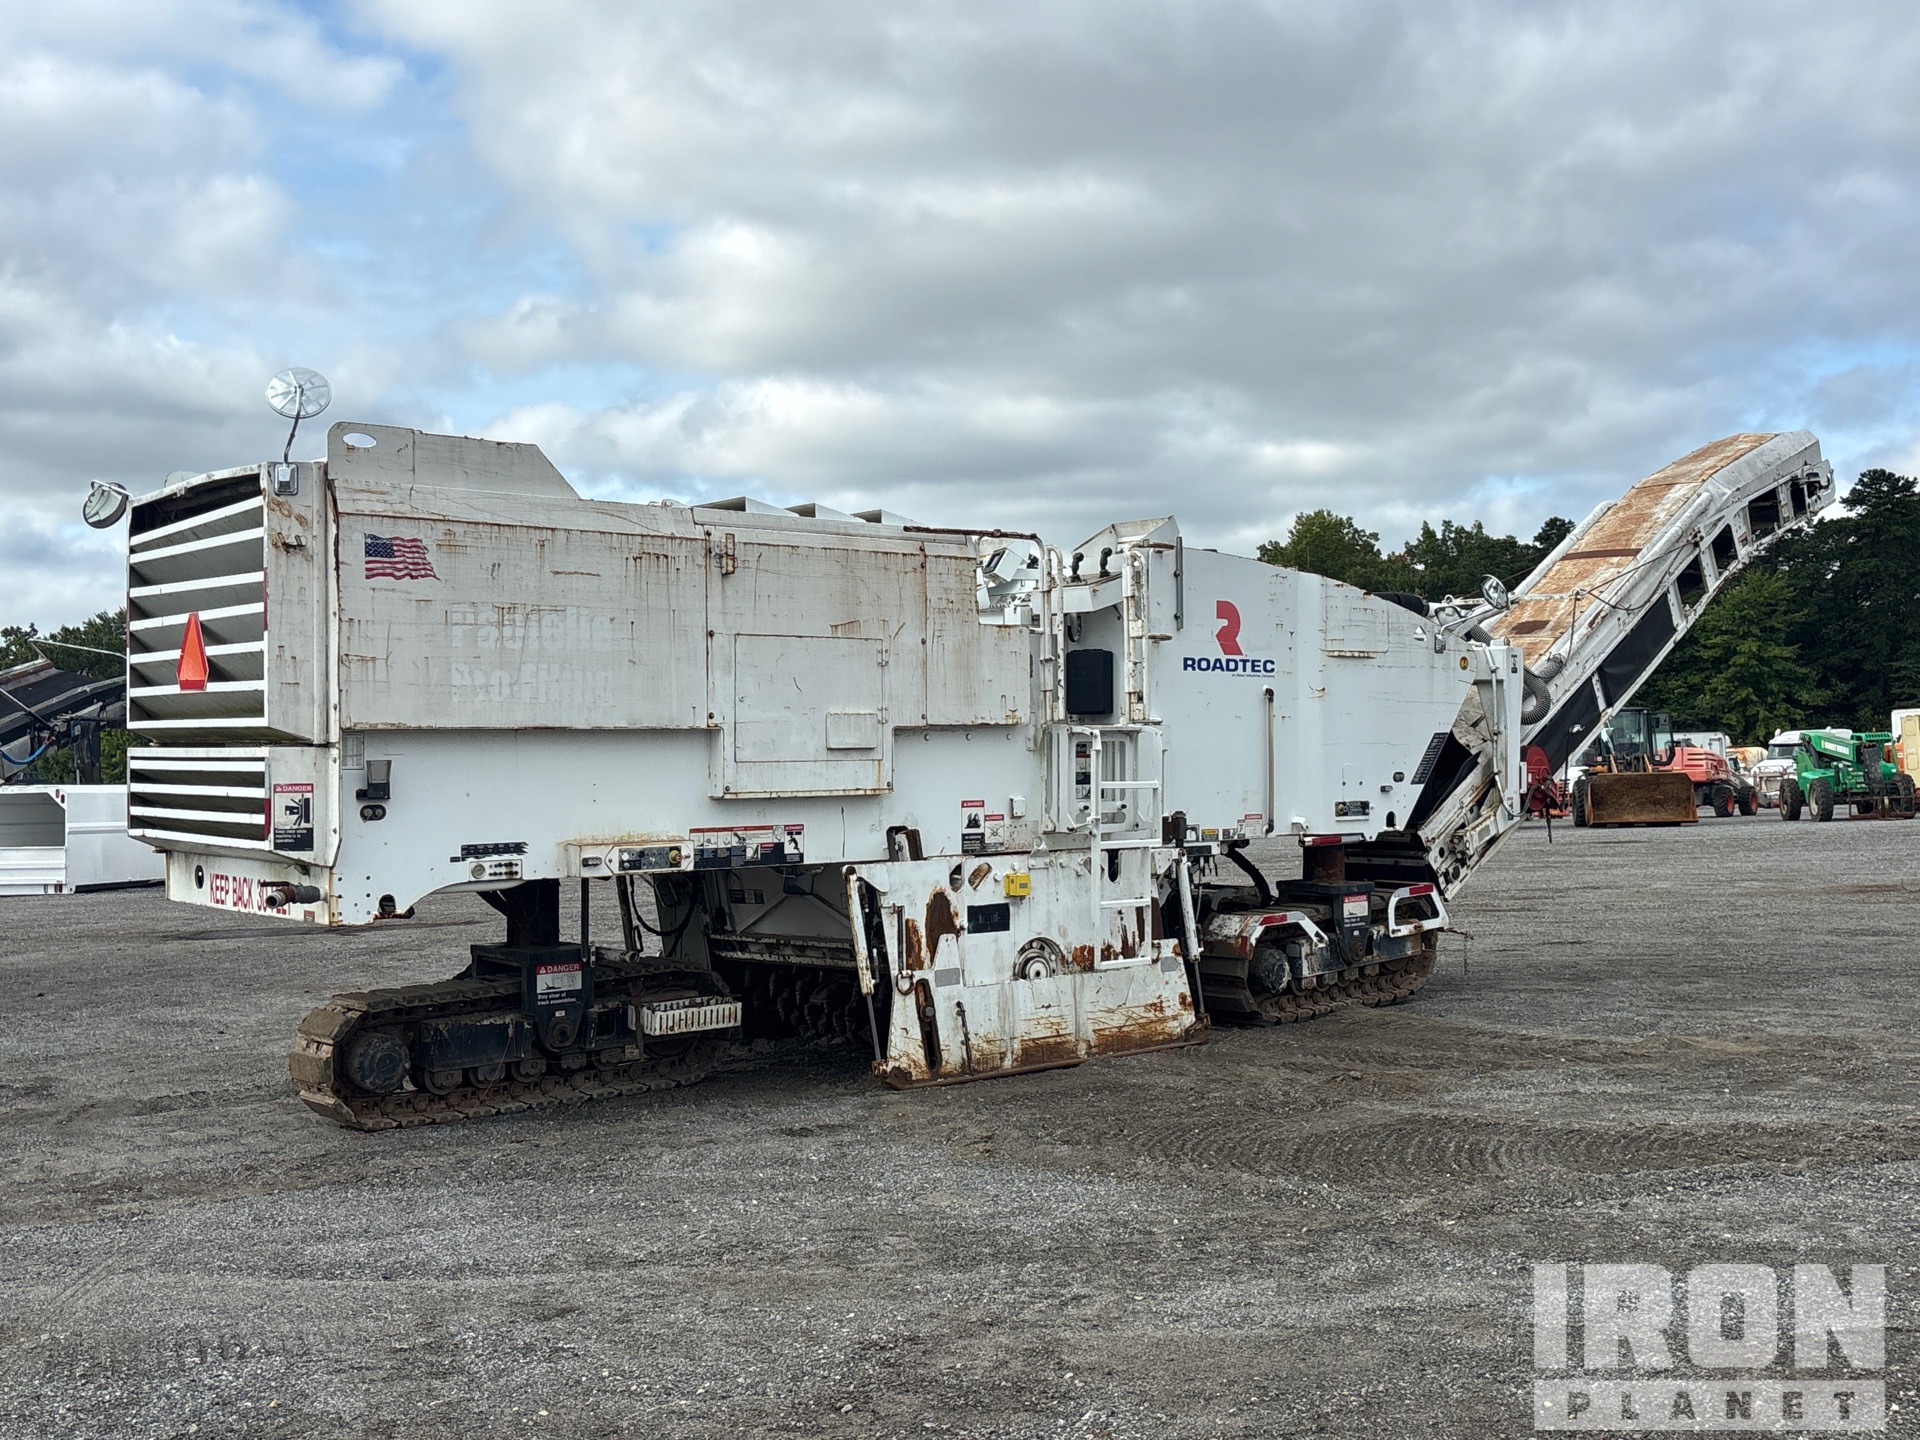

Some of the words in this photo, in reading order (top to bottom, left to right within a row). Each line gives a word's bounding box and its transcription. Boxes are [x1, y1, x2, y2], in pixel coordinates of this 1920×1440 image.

[1183, 656, 1276, 674] ROADTEC
[209, 873, 230, 906] KEEP
[232, 876, 254, 910] BACK
[547, 963, 580, 973] DANGER
